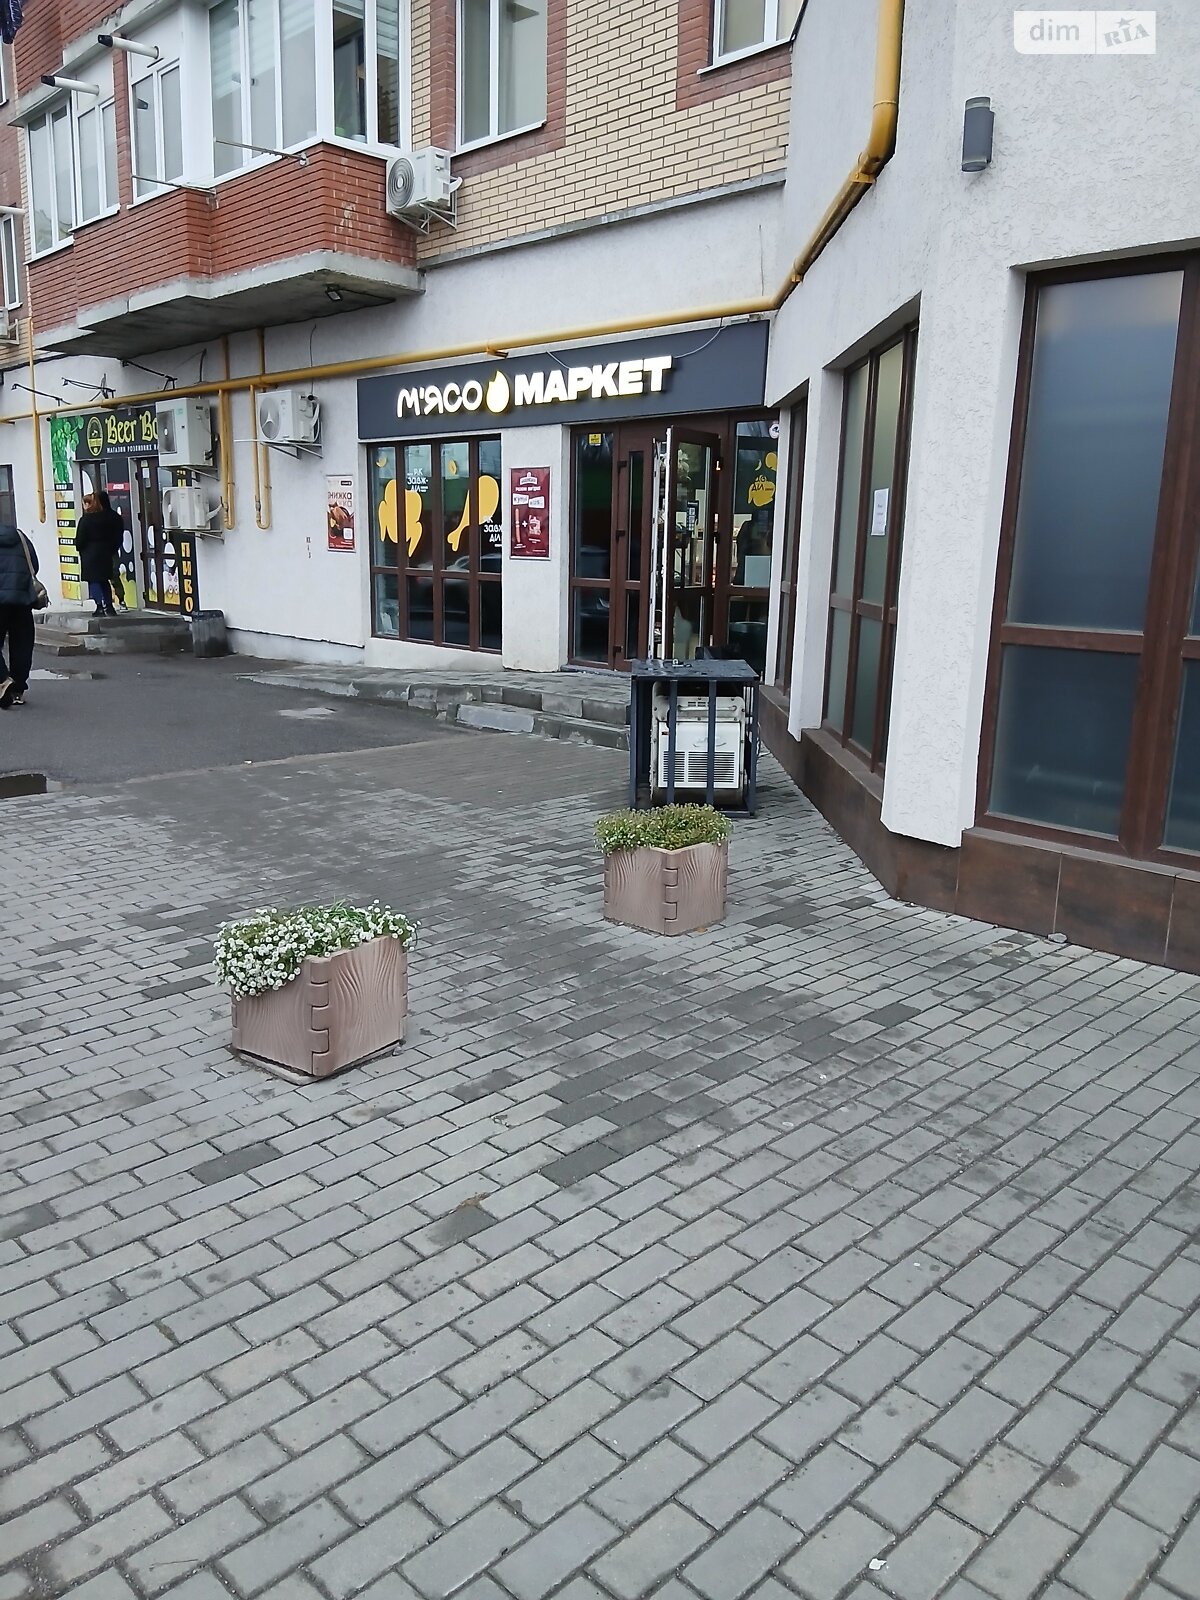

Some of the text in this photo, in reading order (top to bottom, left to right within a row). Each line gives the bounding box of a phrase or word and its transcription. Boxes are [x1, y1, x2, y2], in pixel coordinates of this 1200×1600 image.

[396, 355, 672, 418] М'ЯСО МАРКЕТ
[105, 414, 137, 444] Beer
[181, 542, 194, 612] ПИВО
